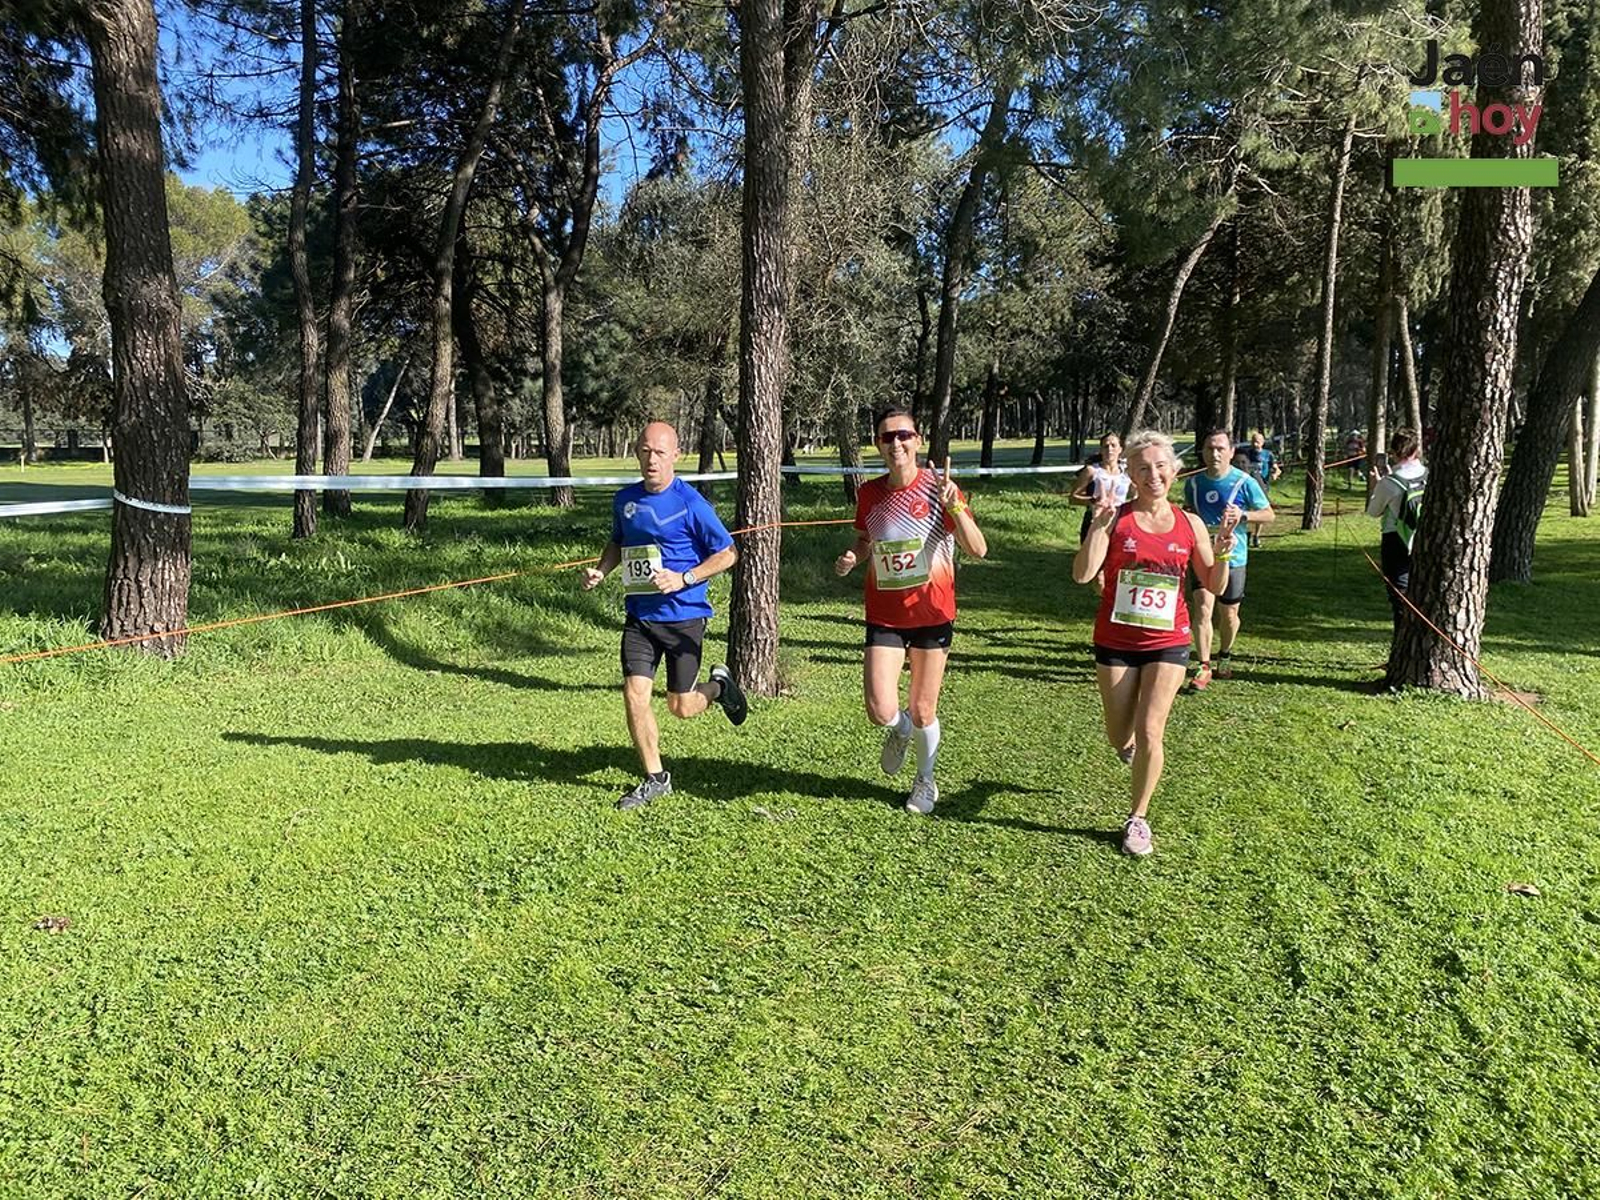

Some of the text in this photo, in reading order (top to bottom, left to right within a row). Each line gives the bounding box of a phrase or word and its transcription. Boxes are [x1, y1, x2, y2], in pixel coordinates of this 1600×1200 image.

[627, 560, 652, 577] 193
[881, 553, 917, 572] 152
[1128, 587, 1167, 609] 153
